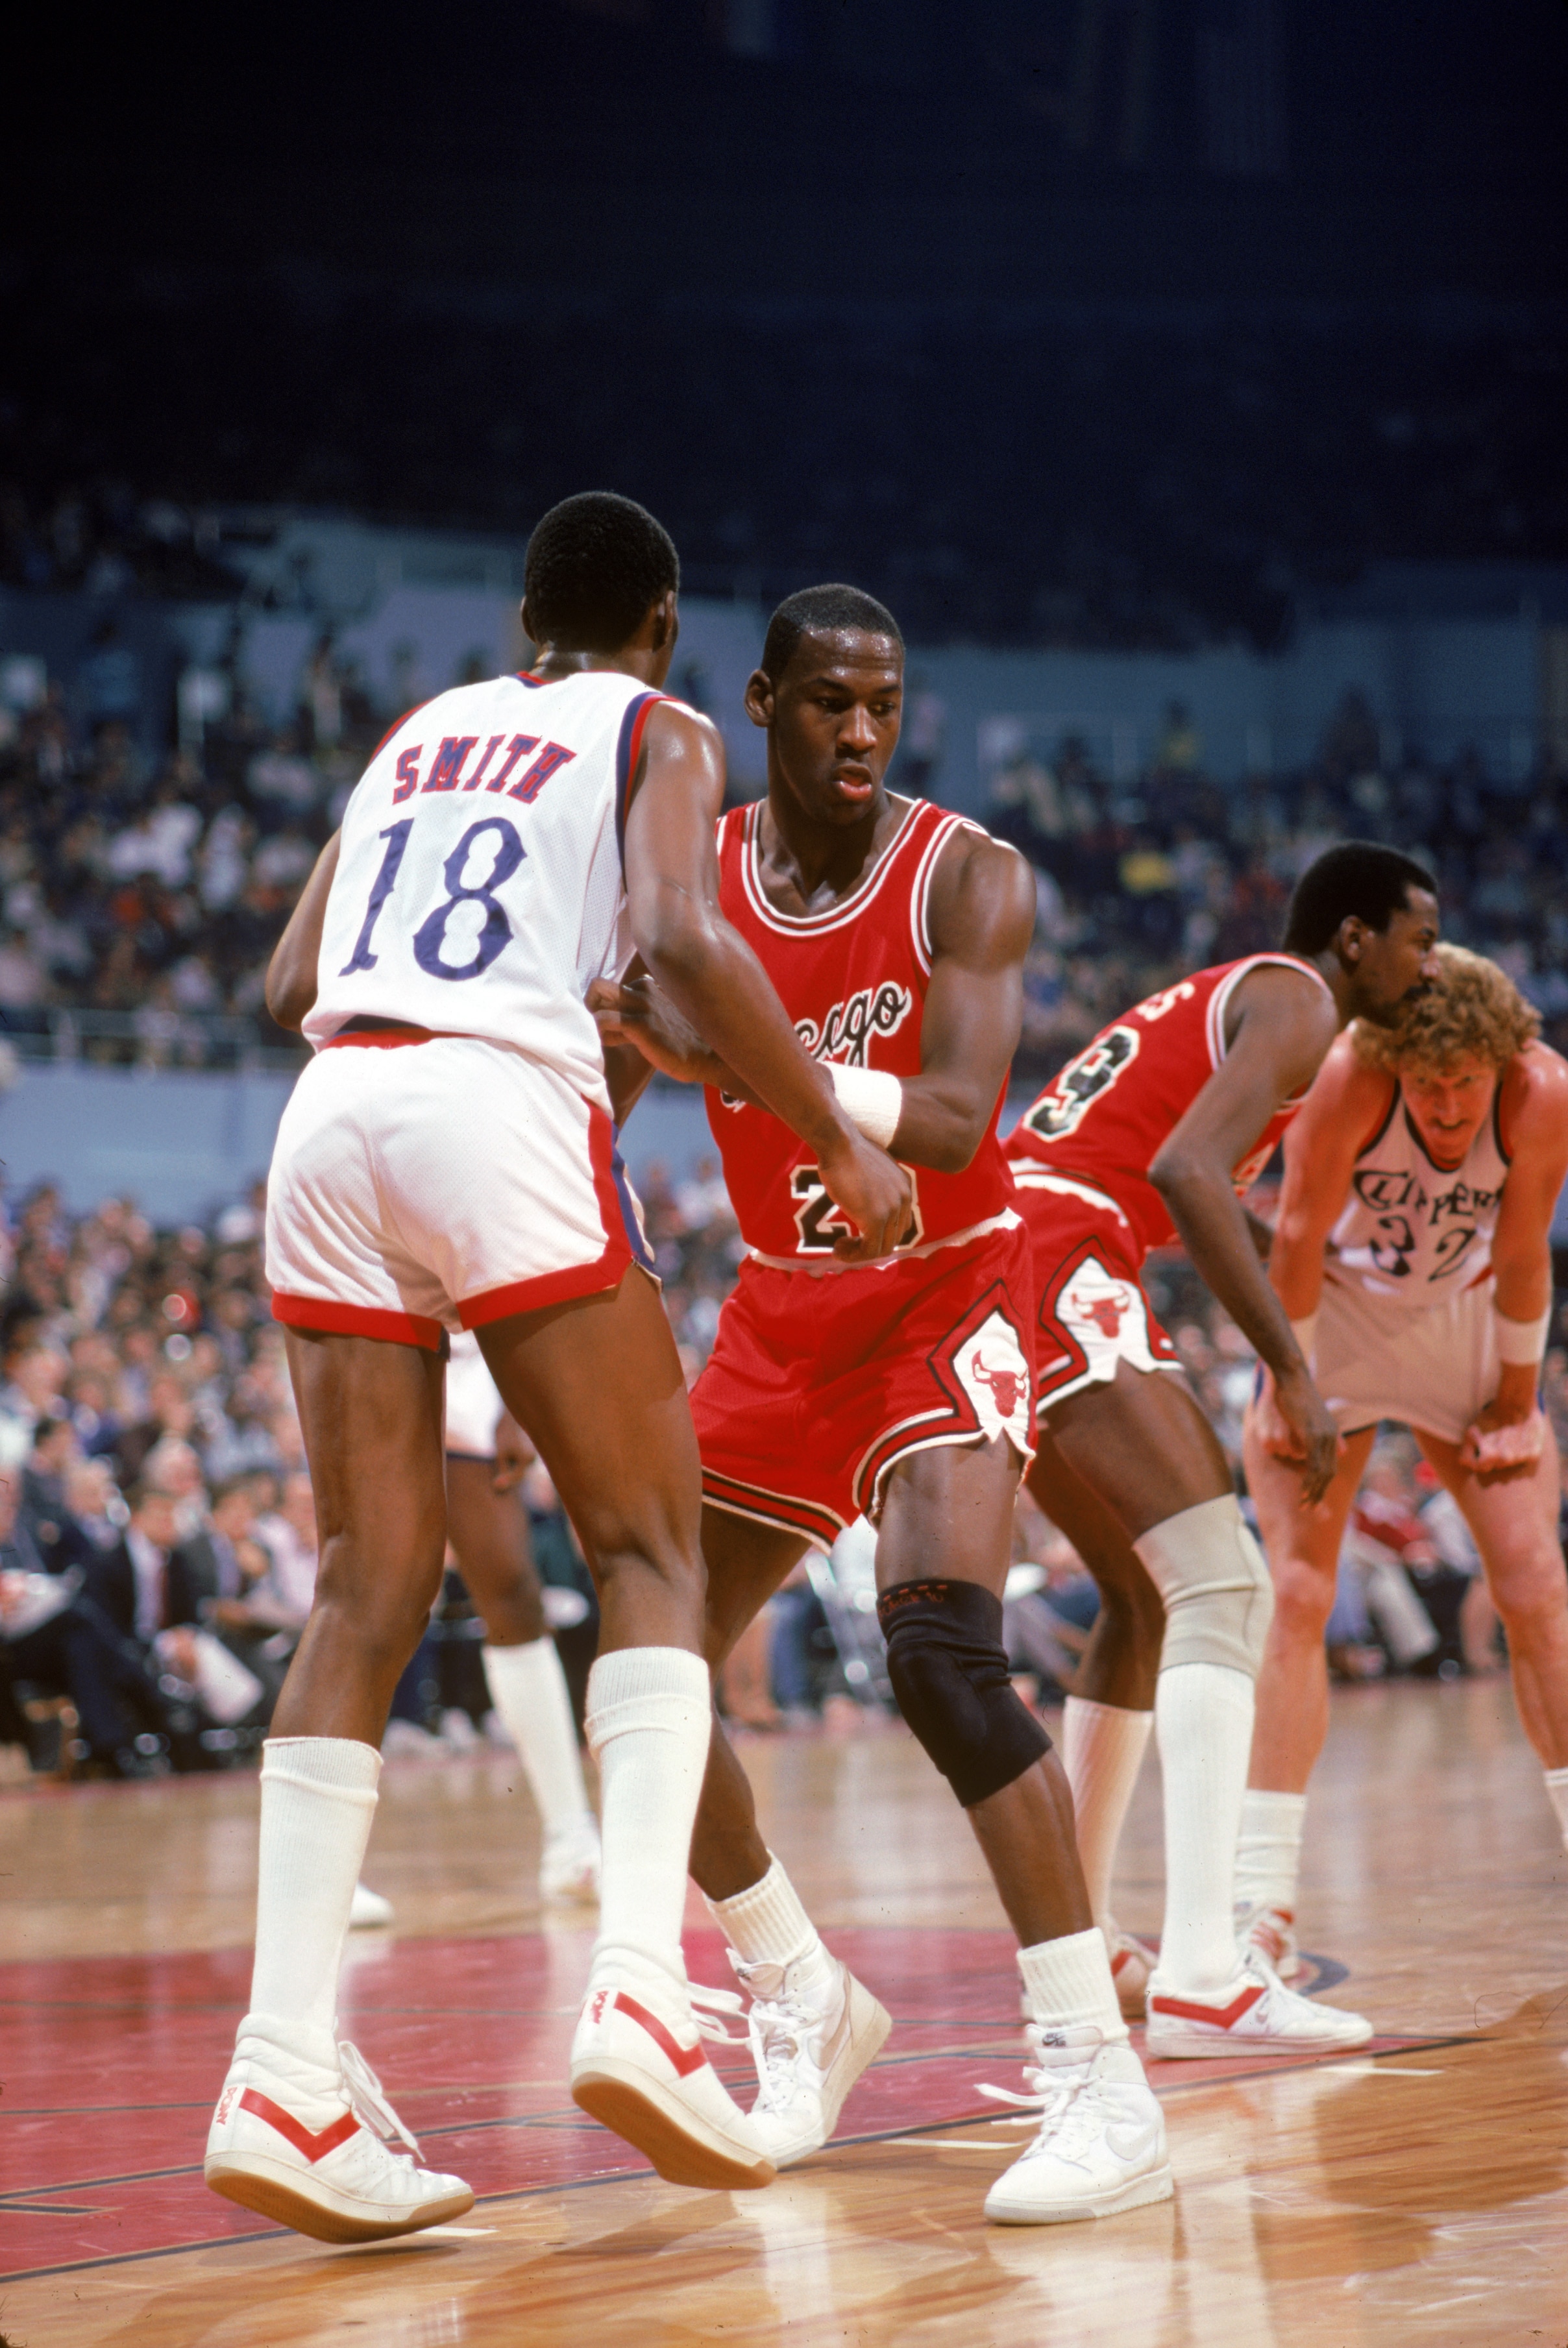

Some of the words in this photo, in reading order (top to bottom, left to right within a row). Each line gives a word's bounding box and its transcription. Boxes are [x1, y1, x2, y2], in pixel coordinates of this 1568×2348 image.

[392, 733, 577, 805] SMITH
[337, 816, 528, 981] 18
[1369, 1216, 1477, 1282] 32
[216, 2086, 238, 2125] PONY
